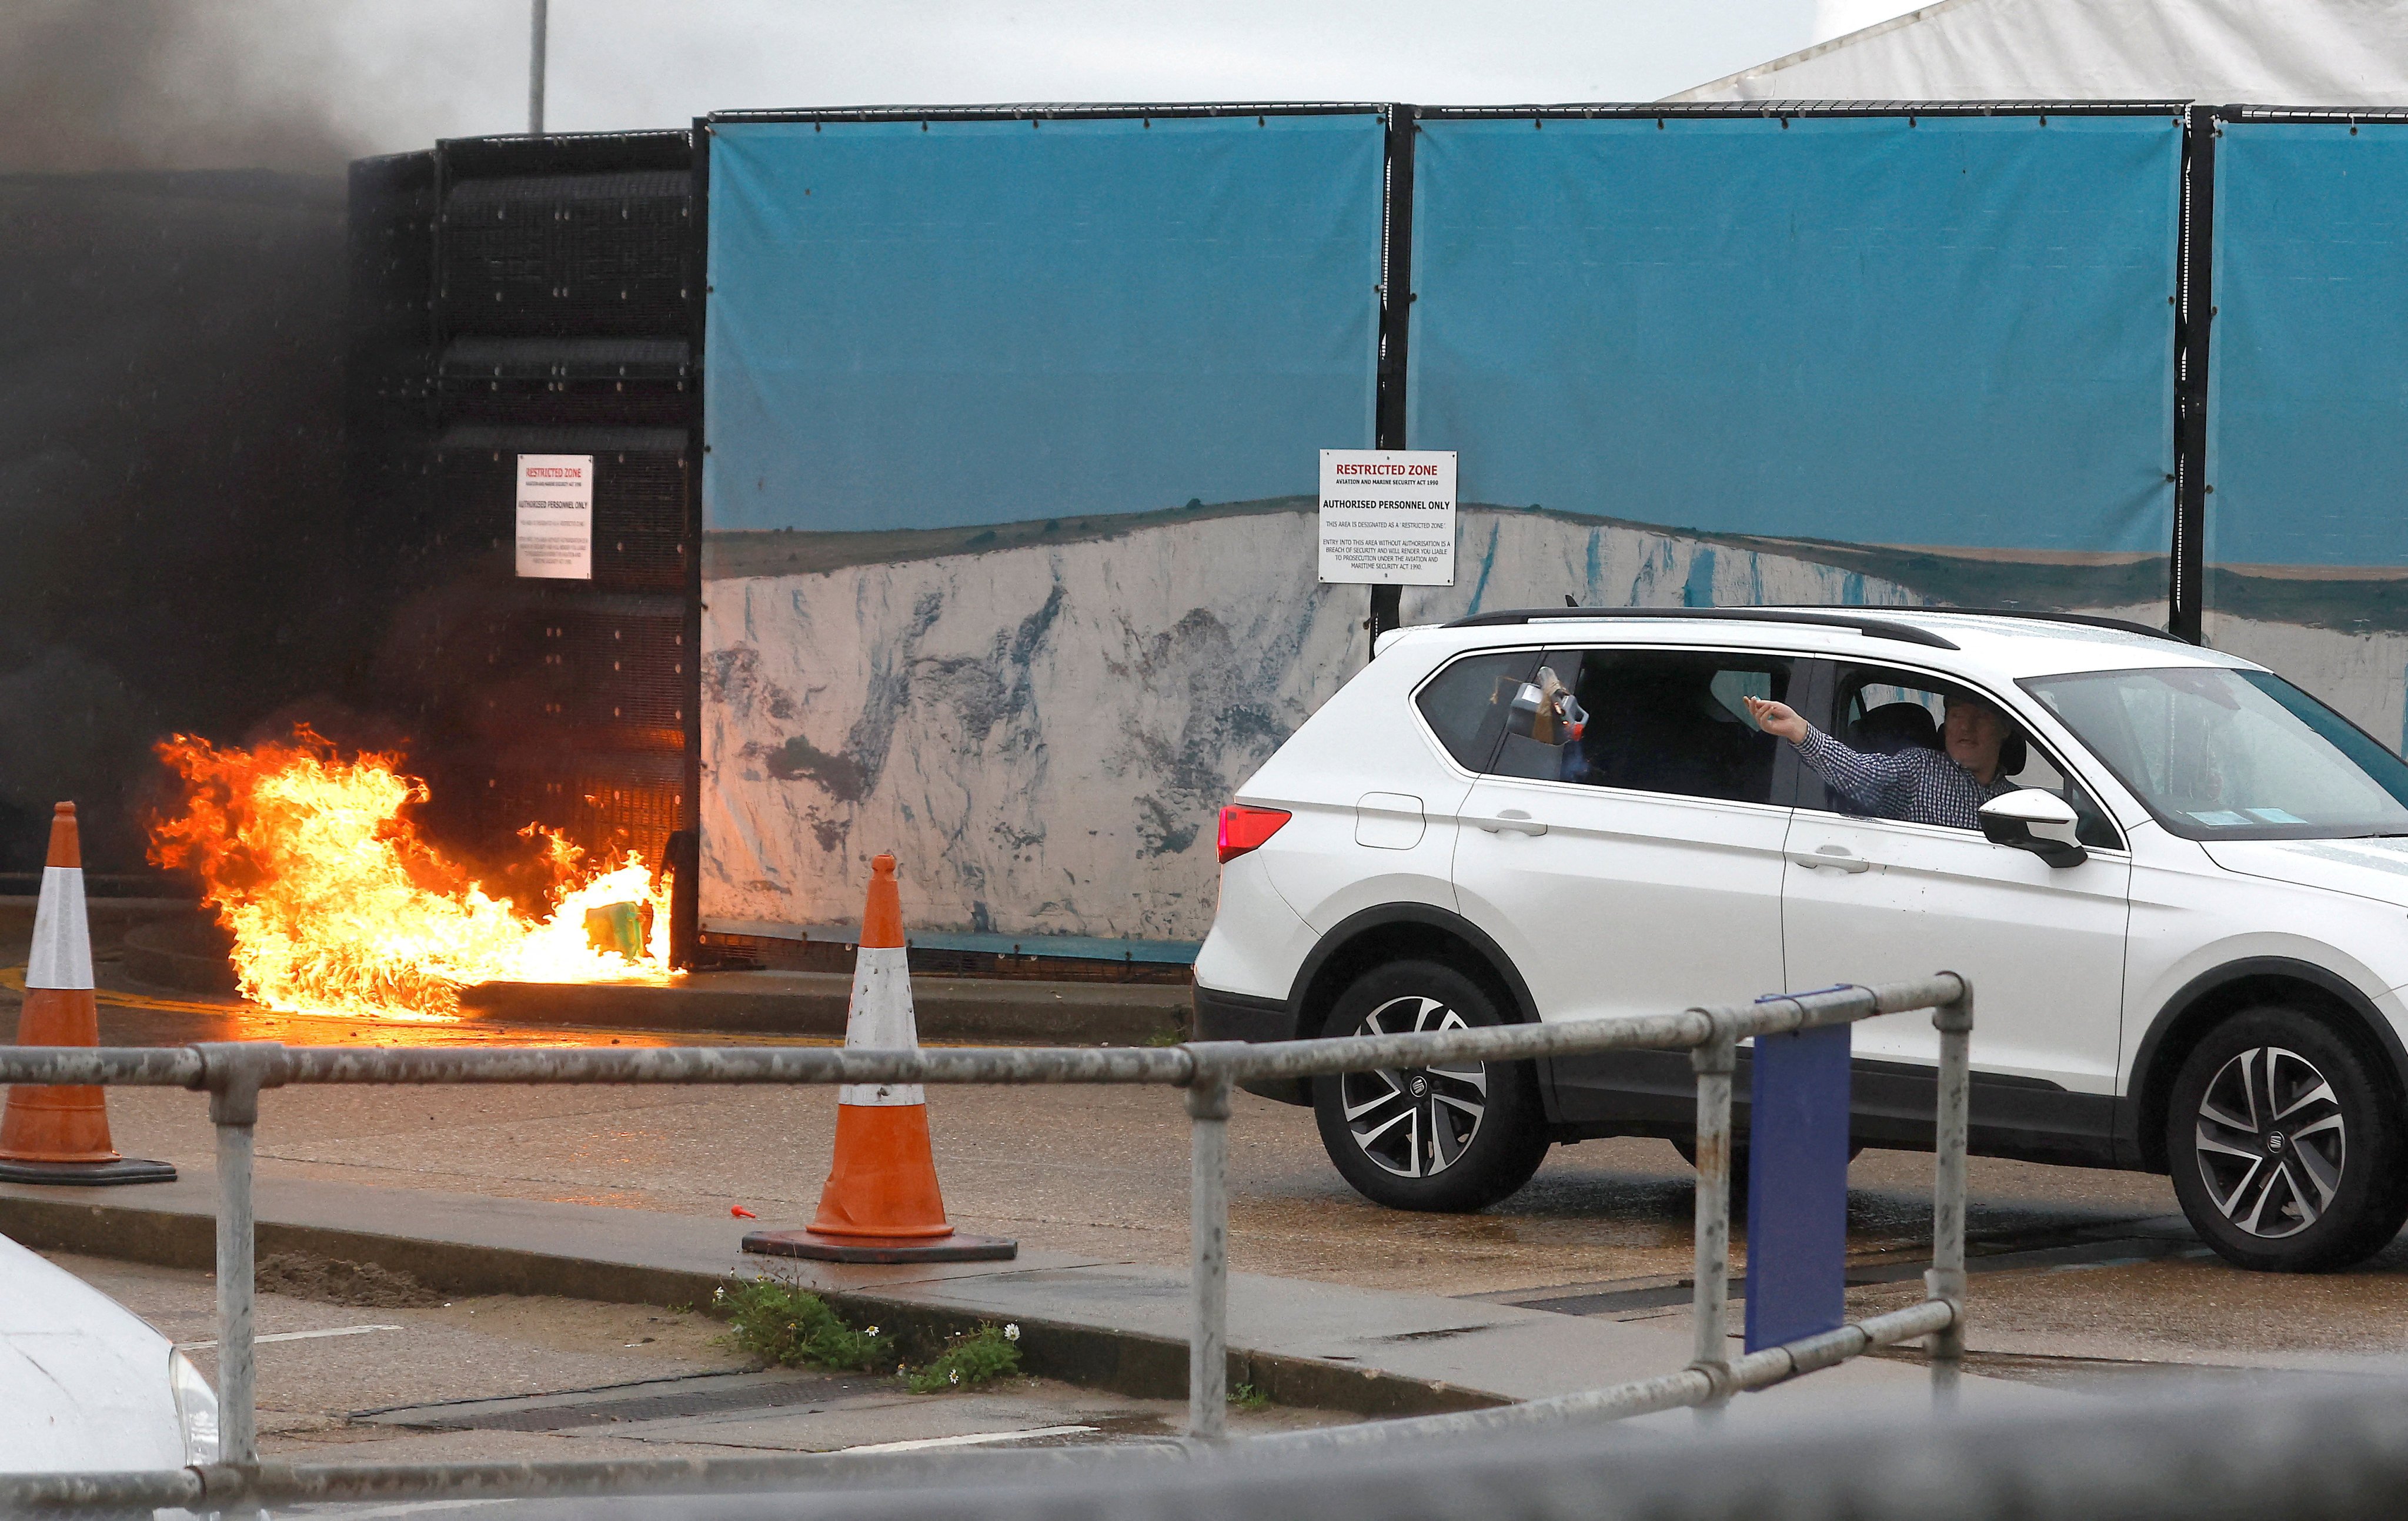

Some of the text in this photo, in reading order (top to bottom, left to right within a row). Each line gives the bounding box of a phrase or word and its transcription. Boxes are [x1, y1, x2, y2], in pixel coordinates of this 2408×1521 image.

[526, 468, 581, 477] RESTRICTED ZONE
[1337, 464, 1438, 476] RESTRICTED ZONE
[1322, 500, 1450, 510] AUTHORISED PERSONNEL ONLY
